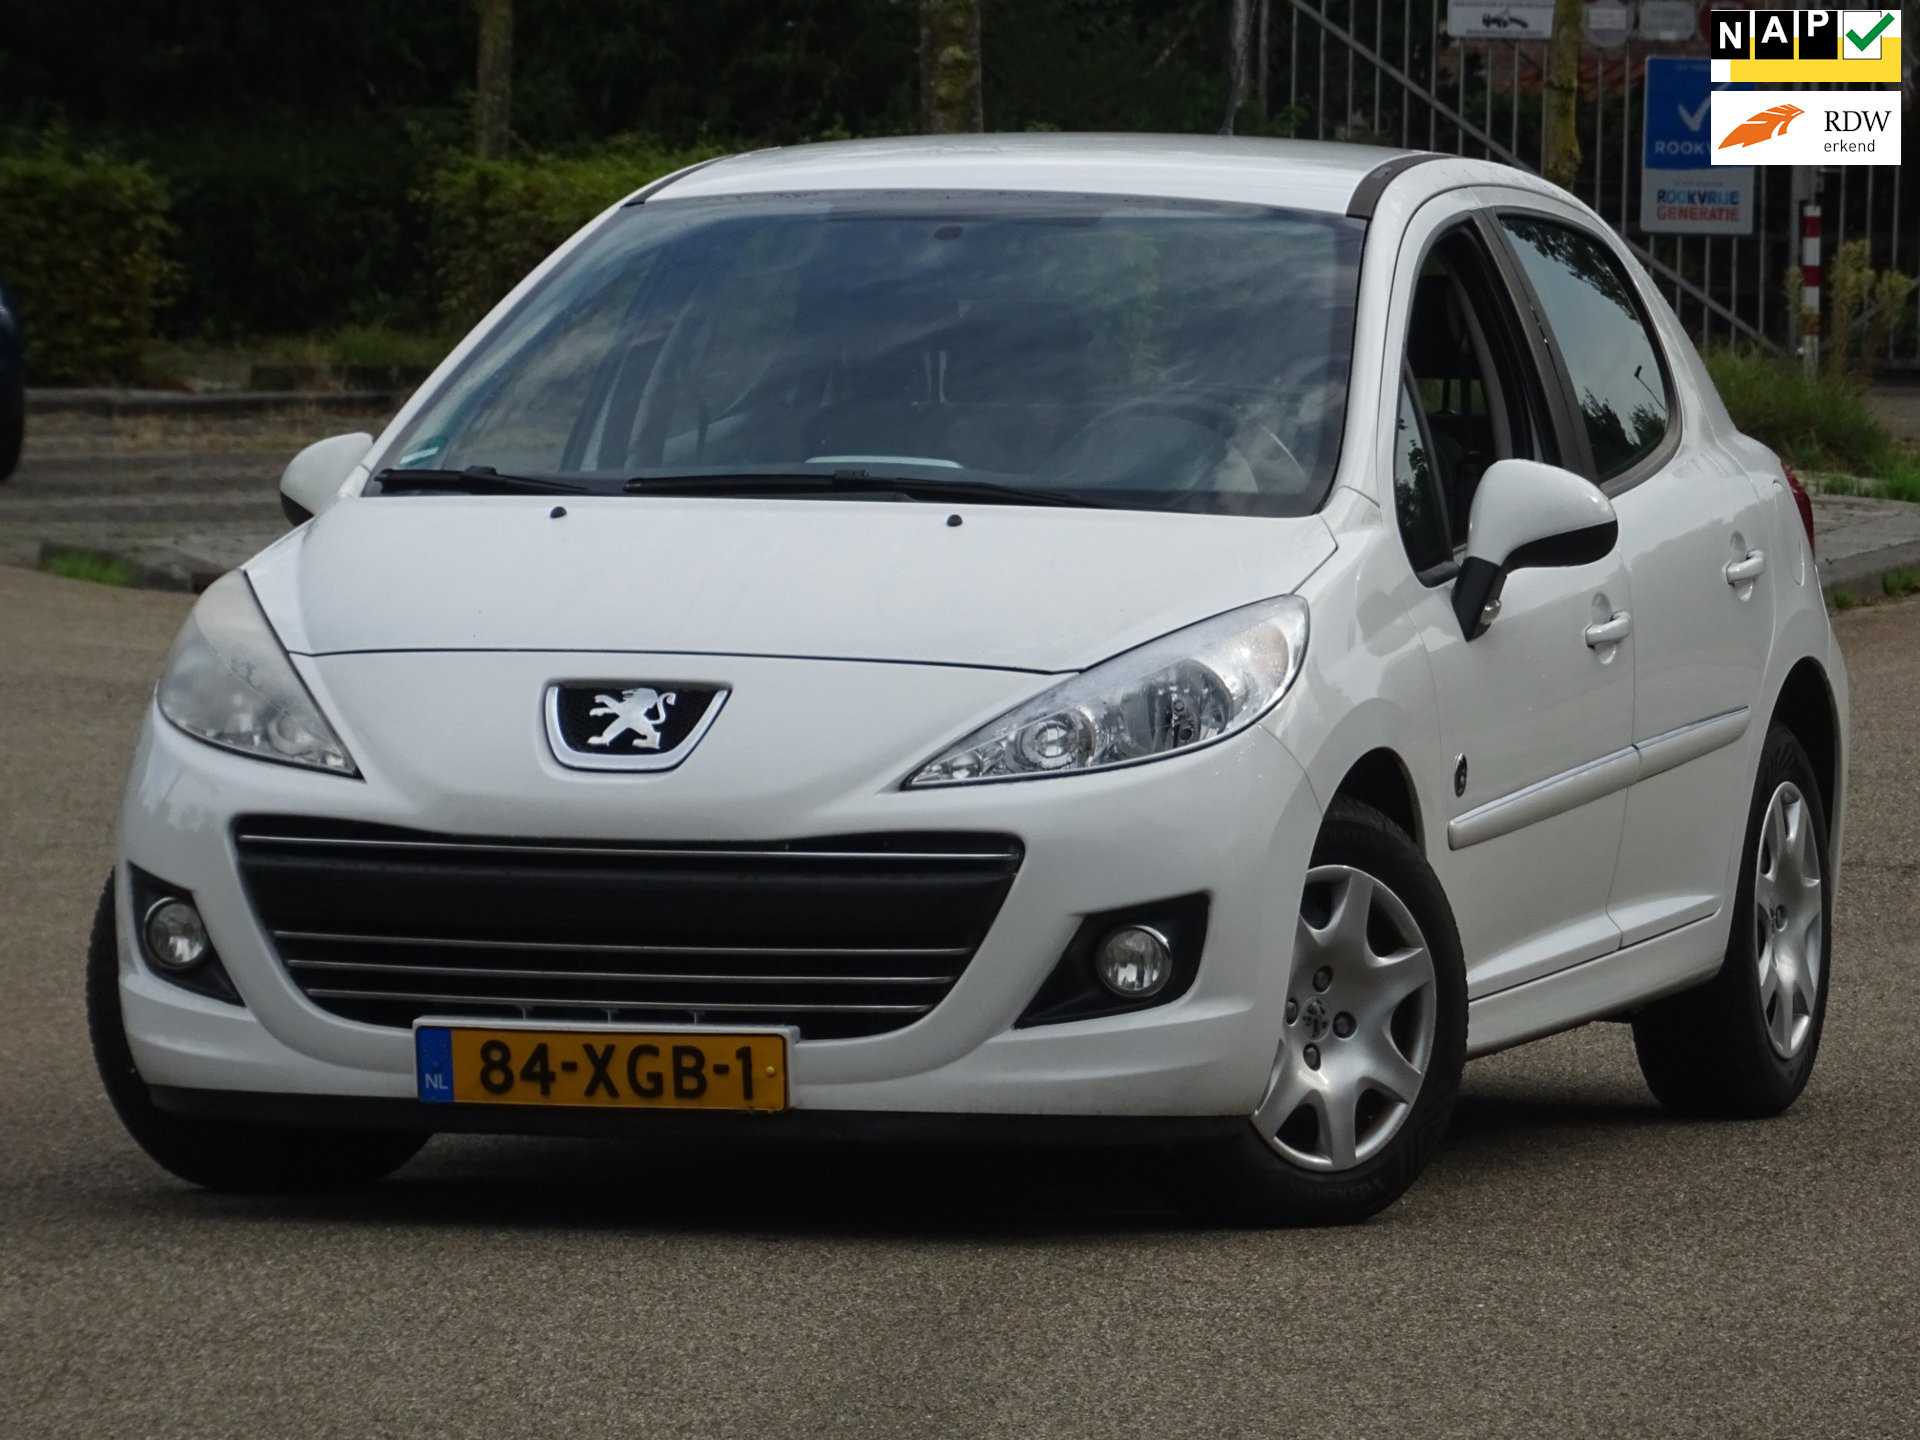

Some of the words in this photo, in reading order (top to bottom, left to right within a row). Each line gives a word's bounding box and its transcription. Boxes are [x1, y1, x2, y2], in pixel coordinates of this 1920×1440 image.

[1656, 205, 1740, 223] GENERATIE
[479, 1039, 753, 1101] 84-XGB-1
[425, 1073, 449, 1090] NL
